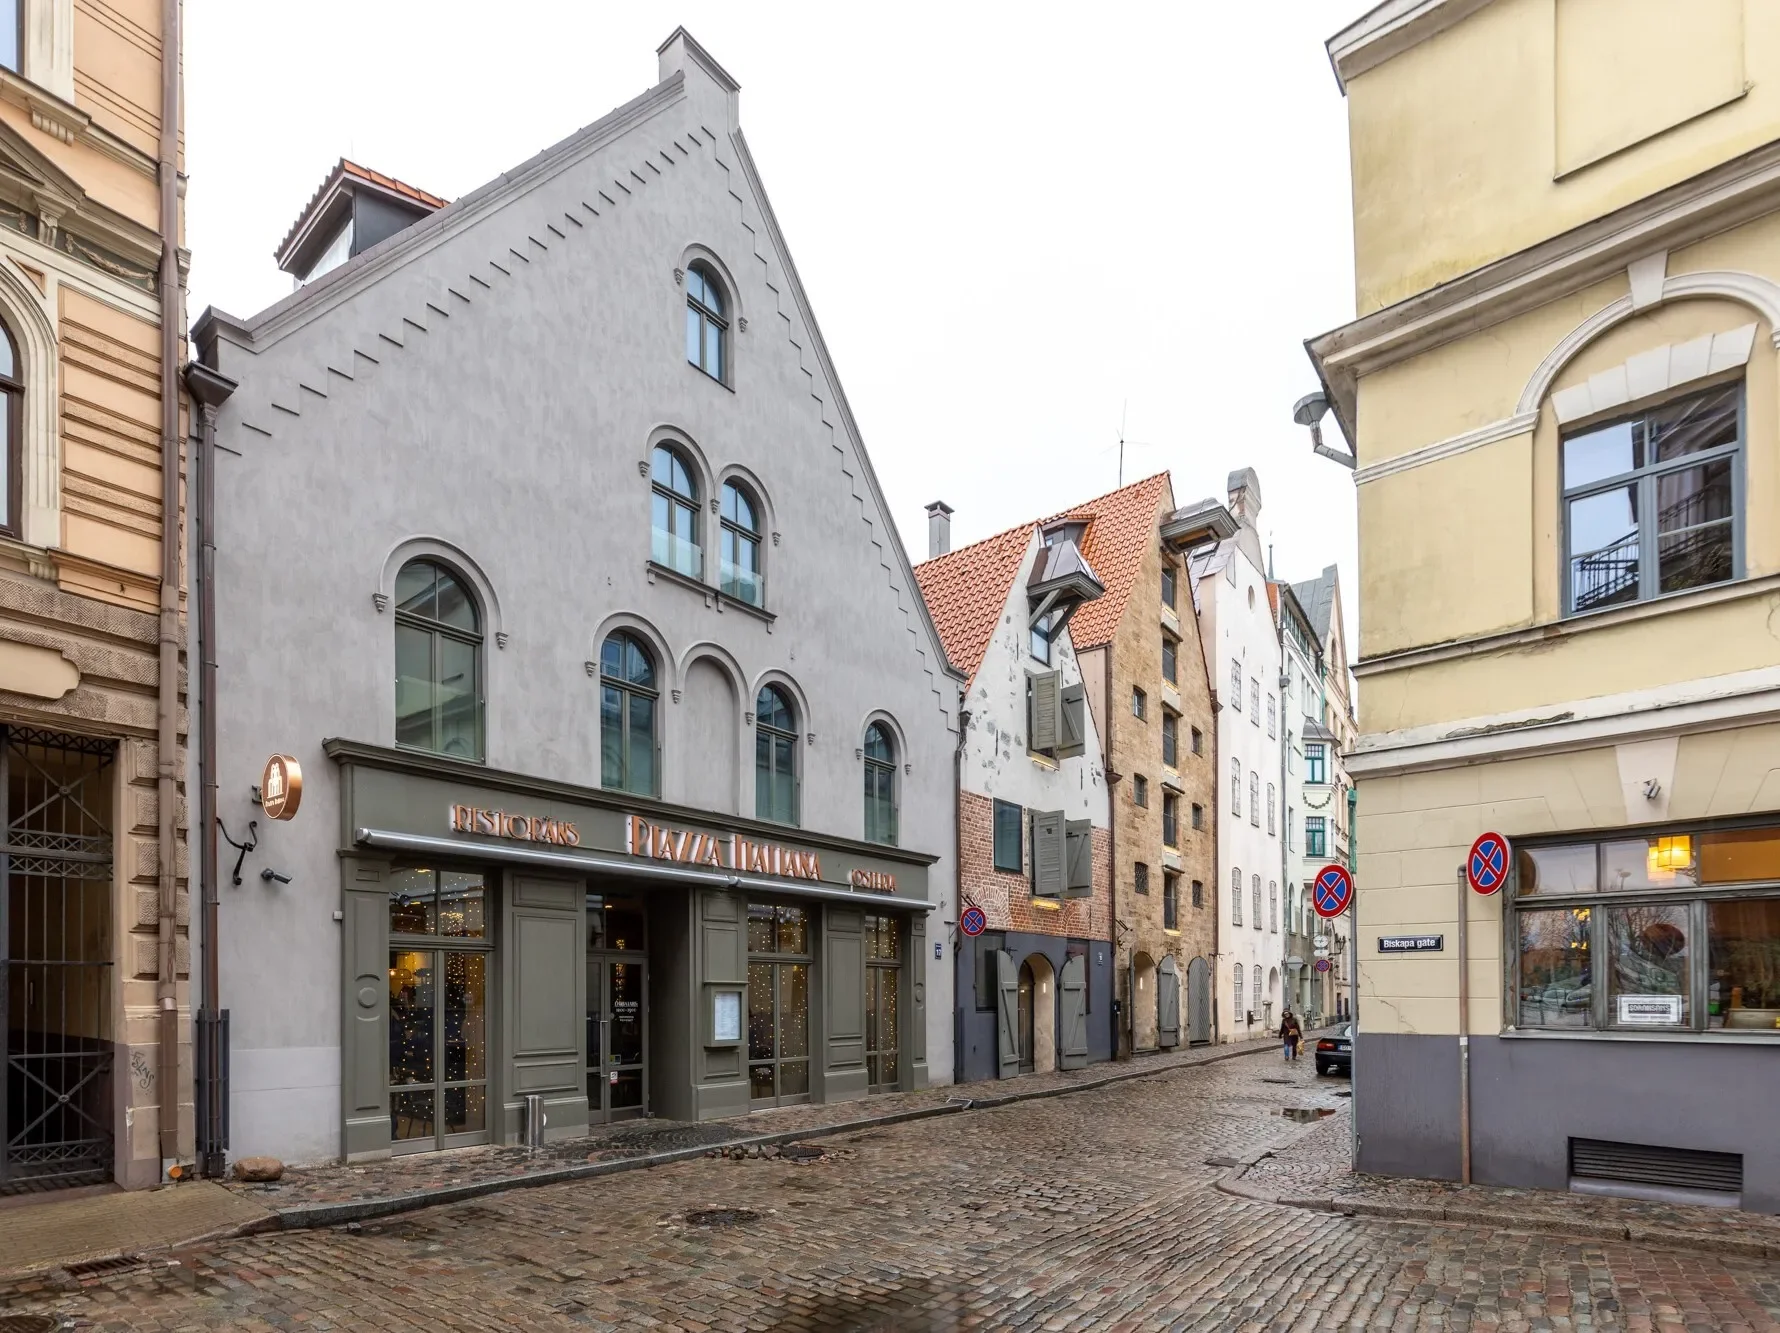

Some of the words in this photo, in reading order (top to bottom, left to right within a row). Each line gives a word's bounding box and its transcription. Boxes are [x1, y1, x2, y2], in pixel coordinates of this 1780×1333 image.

[630, 815, 723, 868] PIAZZA
[733, 833, 823, 881] ITALIANA
[851, 868, 896, 892] OSTERIA
